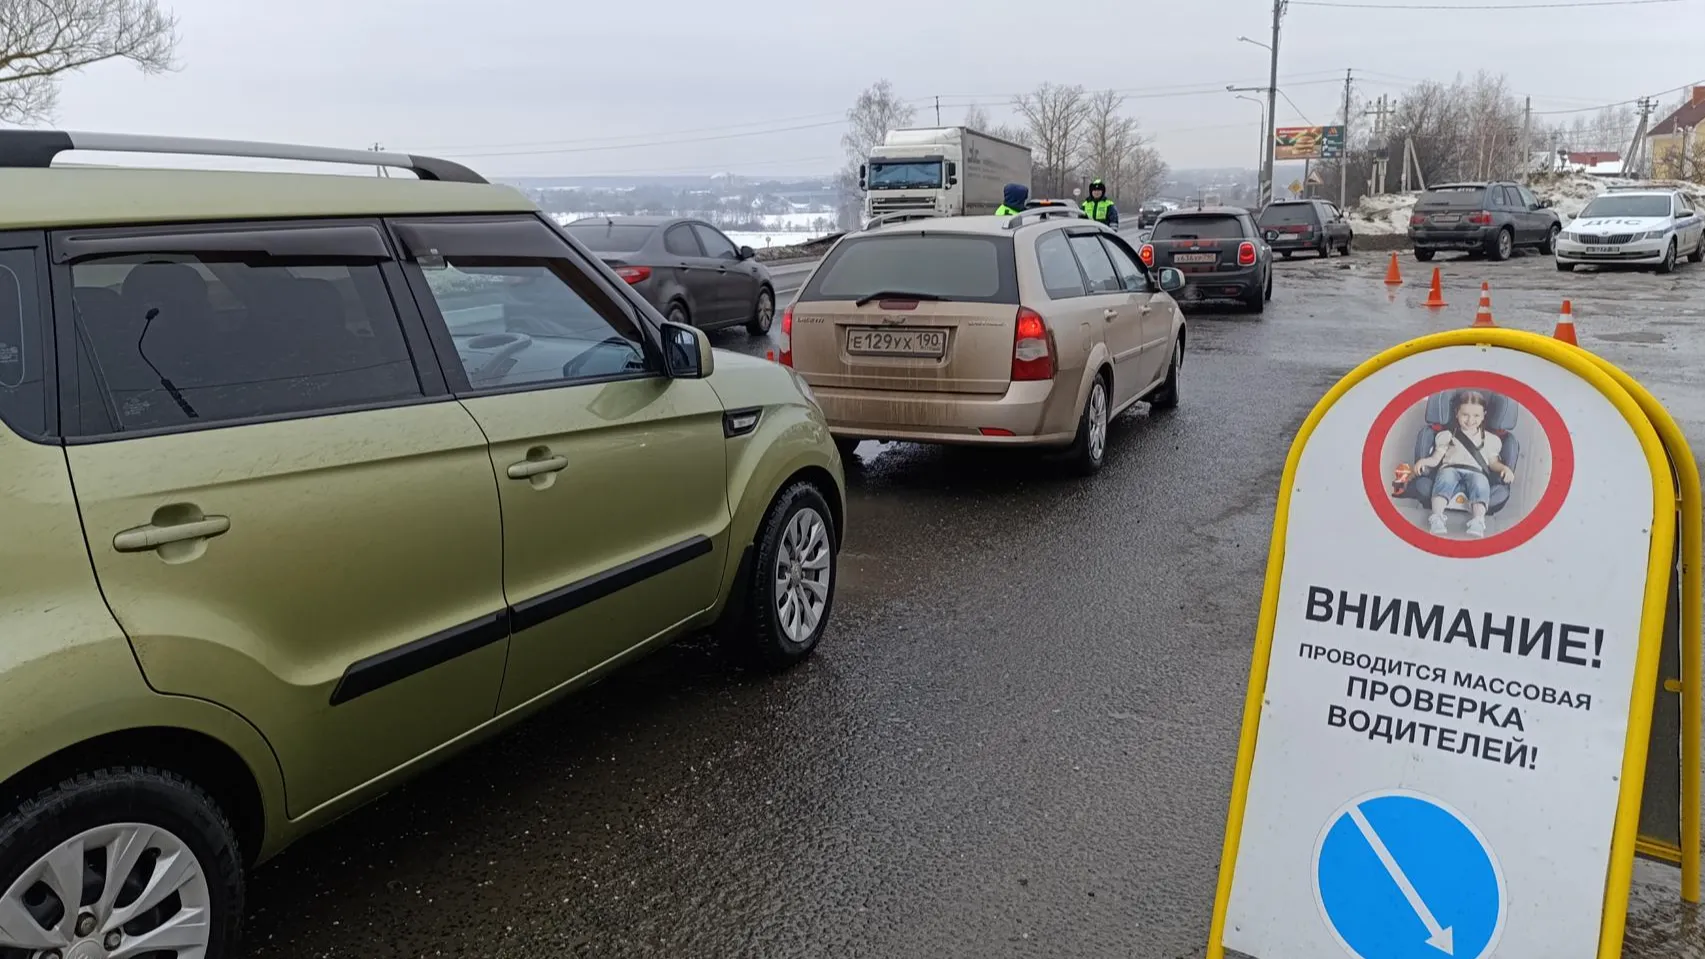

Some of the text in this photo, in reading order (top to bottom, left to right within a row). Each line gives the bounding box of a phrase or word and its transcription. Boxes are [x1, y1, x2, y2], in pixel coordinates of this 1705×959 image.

[1581, 219, 1641, 227] ДПС
[916, 333, 939, 346] 190
[1305, 585, 1604, 668] ВНИМАНИЕ!
[1299, 643, 1592, 711] ПРОВОДИТСЯ МАССОВАЯ
[1346, 675, 1525, 732] ПРОВЕРКА
[1327, 704, 1539, 770] ВОДИТЕЛЕЙ!
